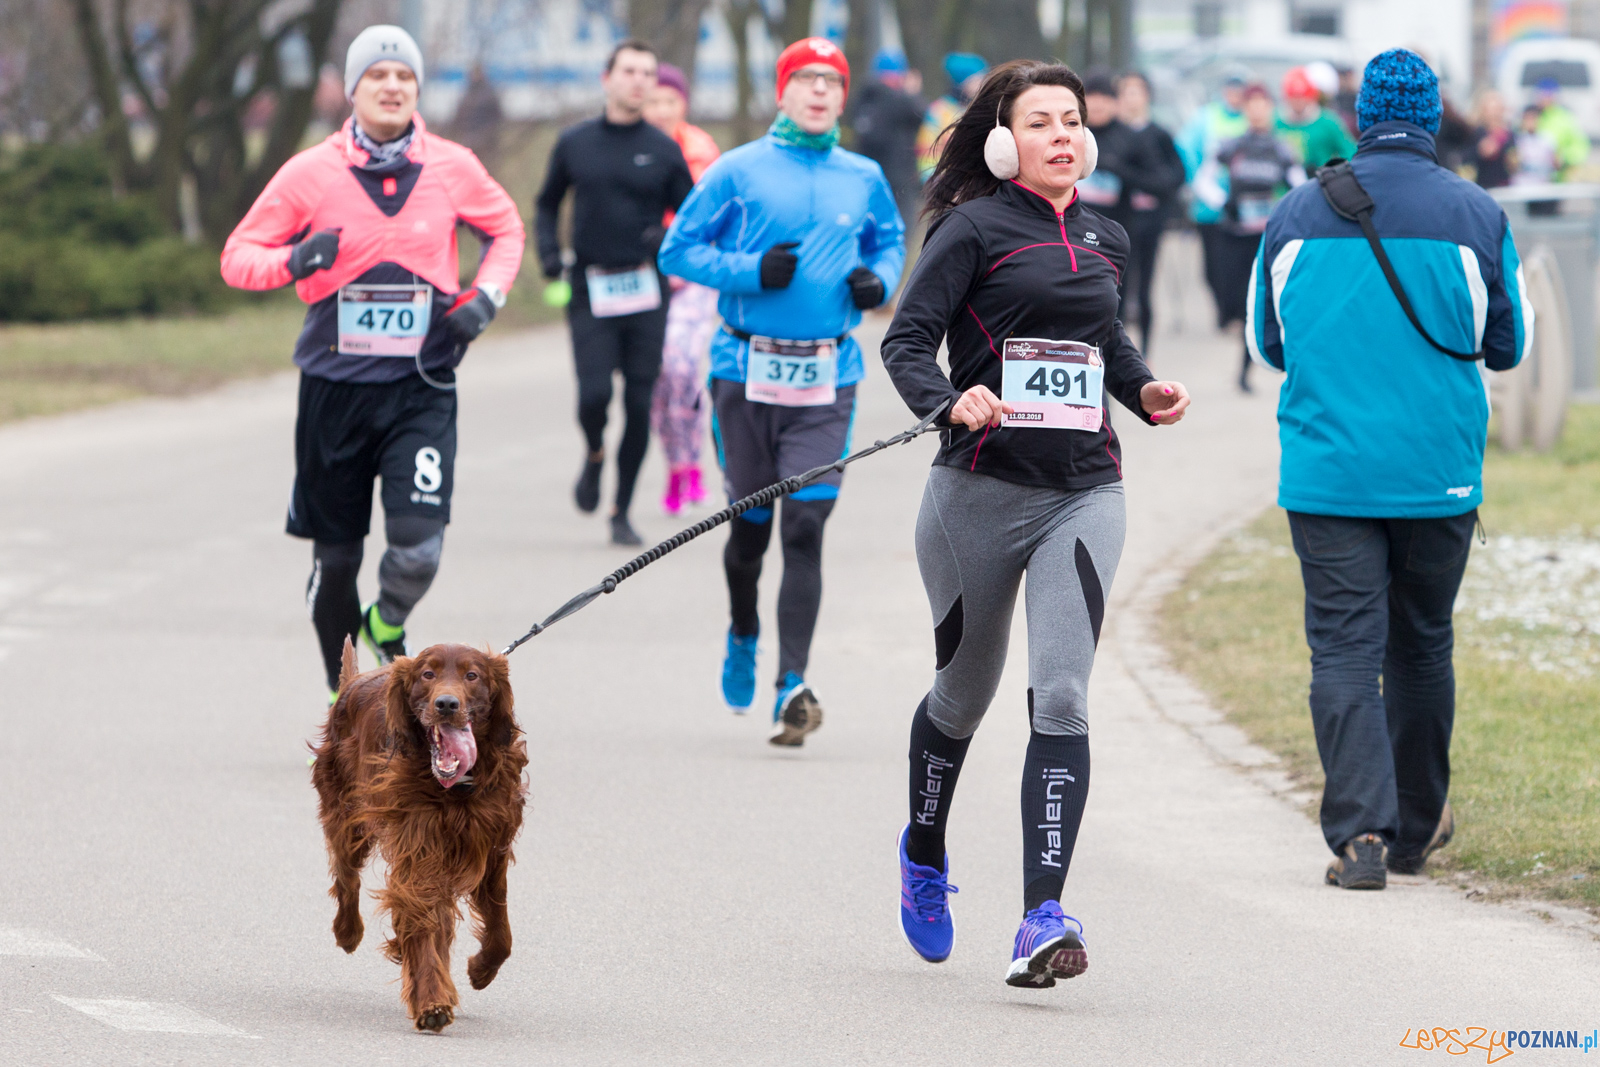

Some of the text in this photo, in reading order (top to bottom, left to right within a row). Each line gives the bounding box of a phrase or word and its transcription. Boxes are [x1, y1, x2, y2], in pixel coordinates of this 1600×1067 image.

[357, 308, 414, 330] 470
[767, 360, 817, 382] 375
[1025, 366, 1087, 399] 491
[1009, 412, 1042, 420] 11.02.2018
[414, 446, 443, 493] 8
